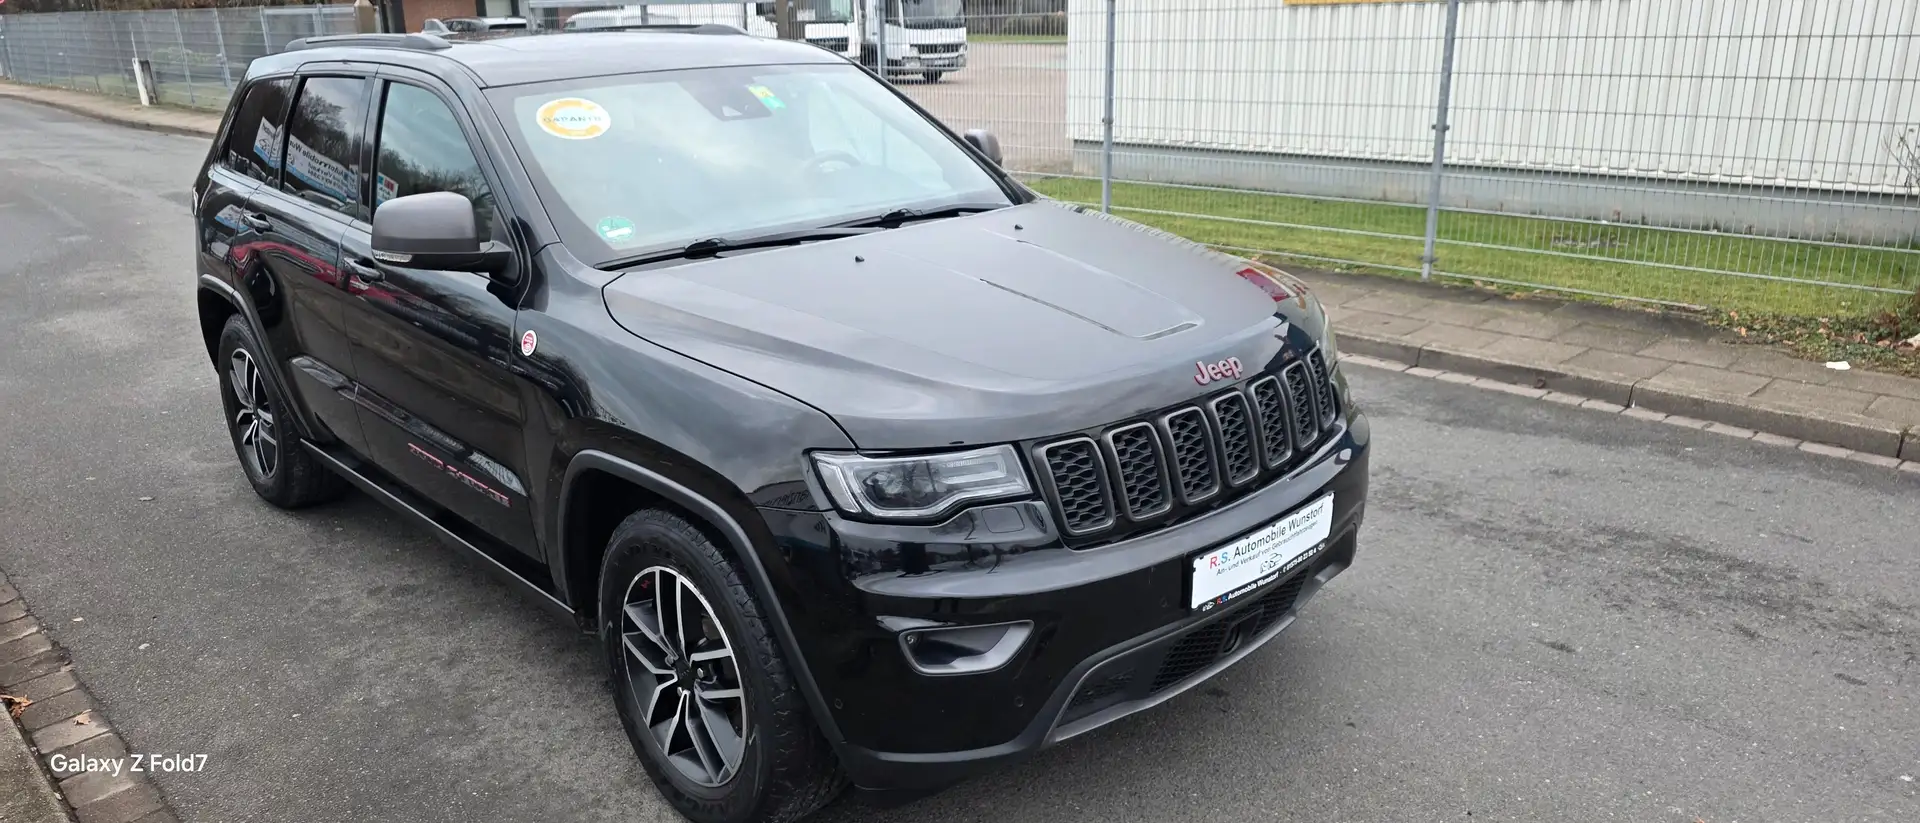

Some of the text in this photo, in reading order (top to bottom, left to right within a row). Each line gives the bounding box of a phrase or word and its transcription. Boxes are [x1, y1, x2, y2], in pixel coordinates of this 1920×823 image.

[1194, 356, 1243, 386] Jeep
[1209, 502, 1324, 569] R.S. Automobile Wunstorf
[1240, 551, 1261, 566] Verkauf
[1228, 582, 1257, 600] Automobile
